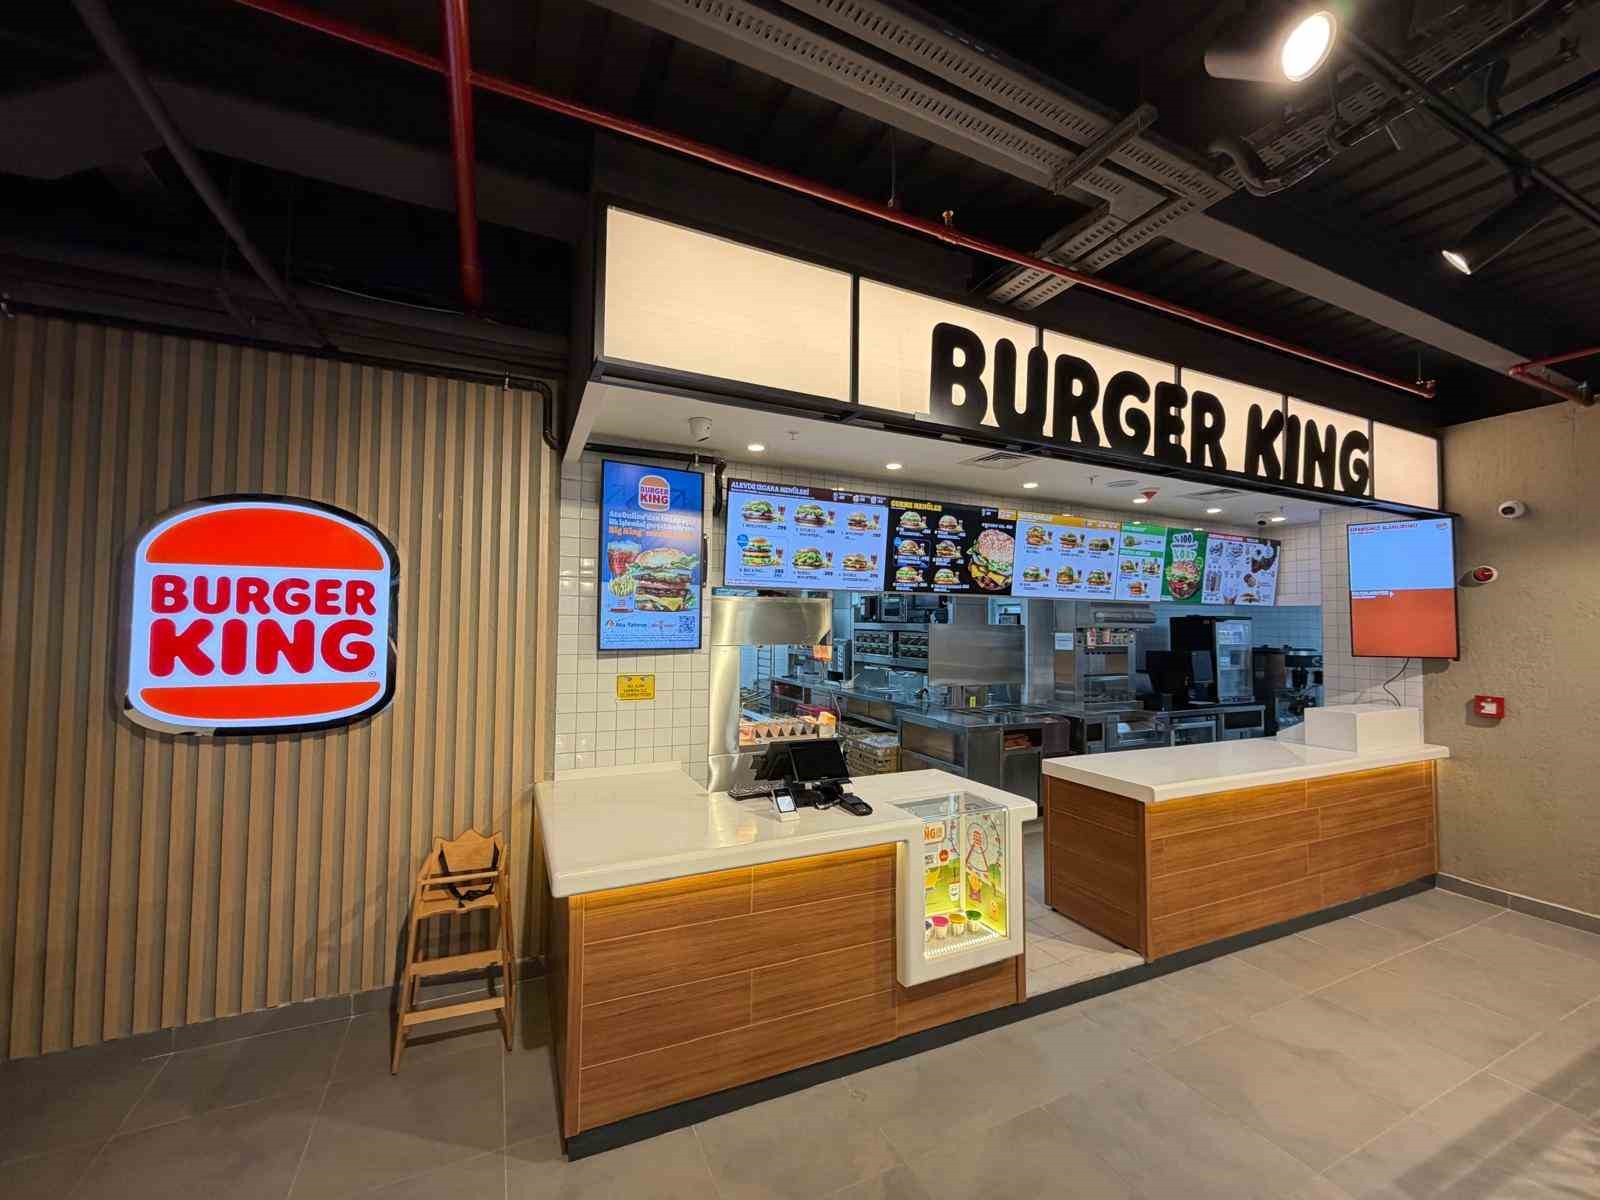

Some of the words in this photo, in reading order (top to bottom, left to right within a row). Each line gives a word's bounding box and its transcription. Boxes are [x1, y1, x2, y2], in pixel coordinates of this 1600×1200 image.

[929, 322, 1227, 473] BURGER
[1244, 403, 1371, 497] KING
[640, 493, 669, 504] KING
[151, 574, 376, 616] BURGER
[149, 618, 376, 677] KING
